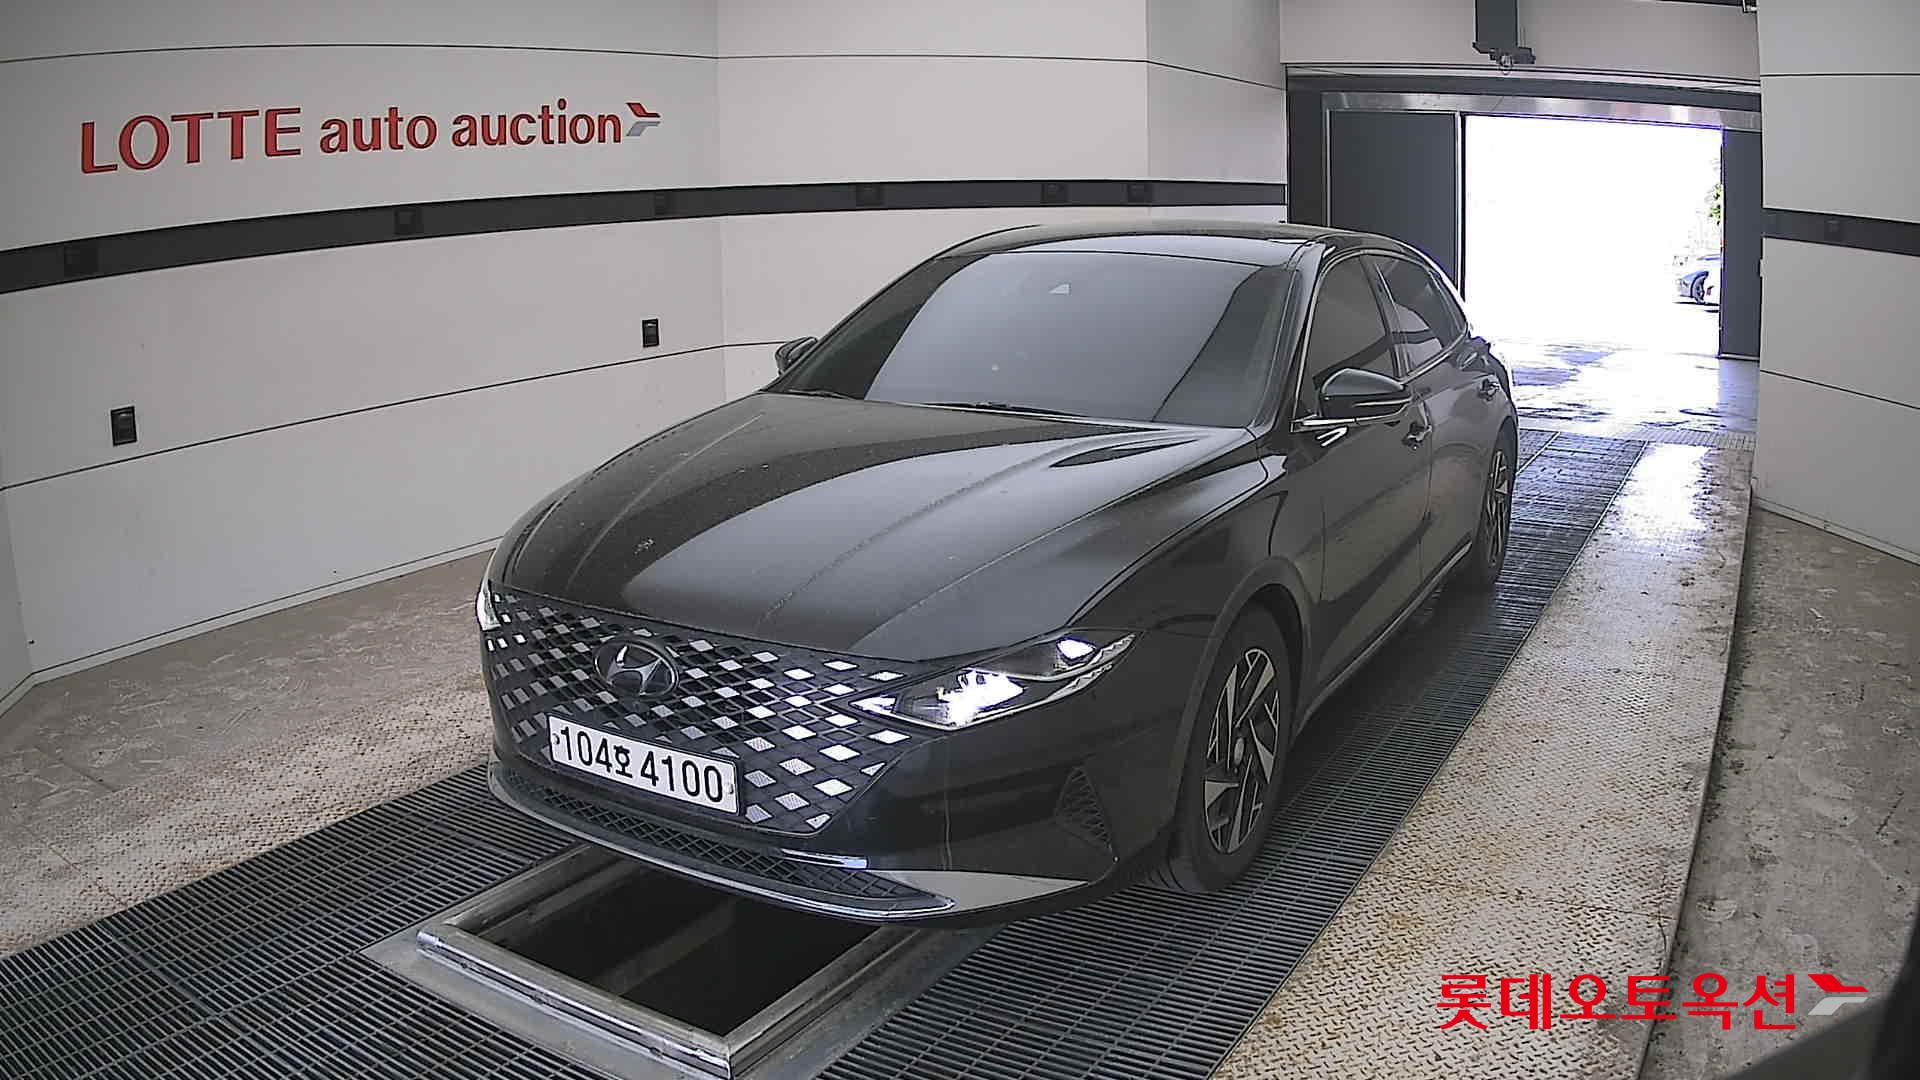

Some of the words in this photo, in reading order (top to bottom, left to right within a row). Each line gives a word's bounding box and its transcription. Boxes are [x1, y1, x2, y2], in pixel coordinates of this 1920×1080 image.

[80, 107, 301, 174] LOTTE
[319, 106, 437, 153] auto
[451, 98, 622, 147] auction
[561, 726, 633, 779] 104호
[640, 751, 723, 803] 4100
